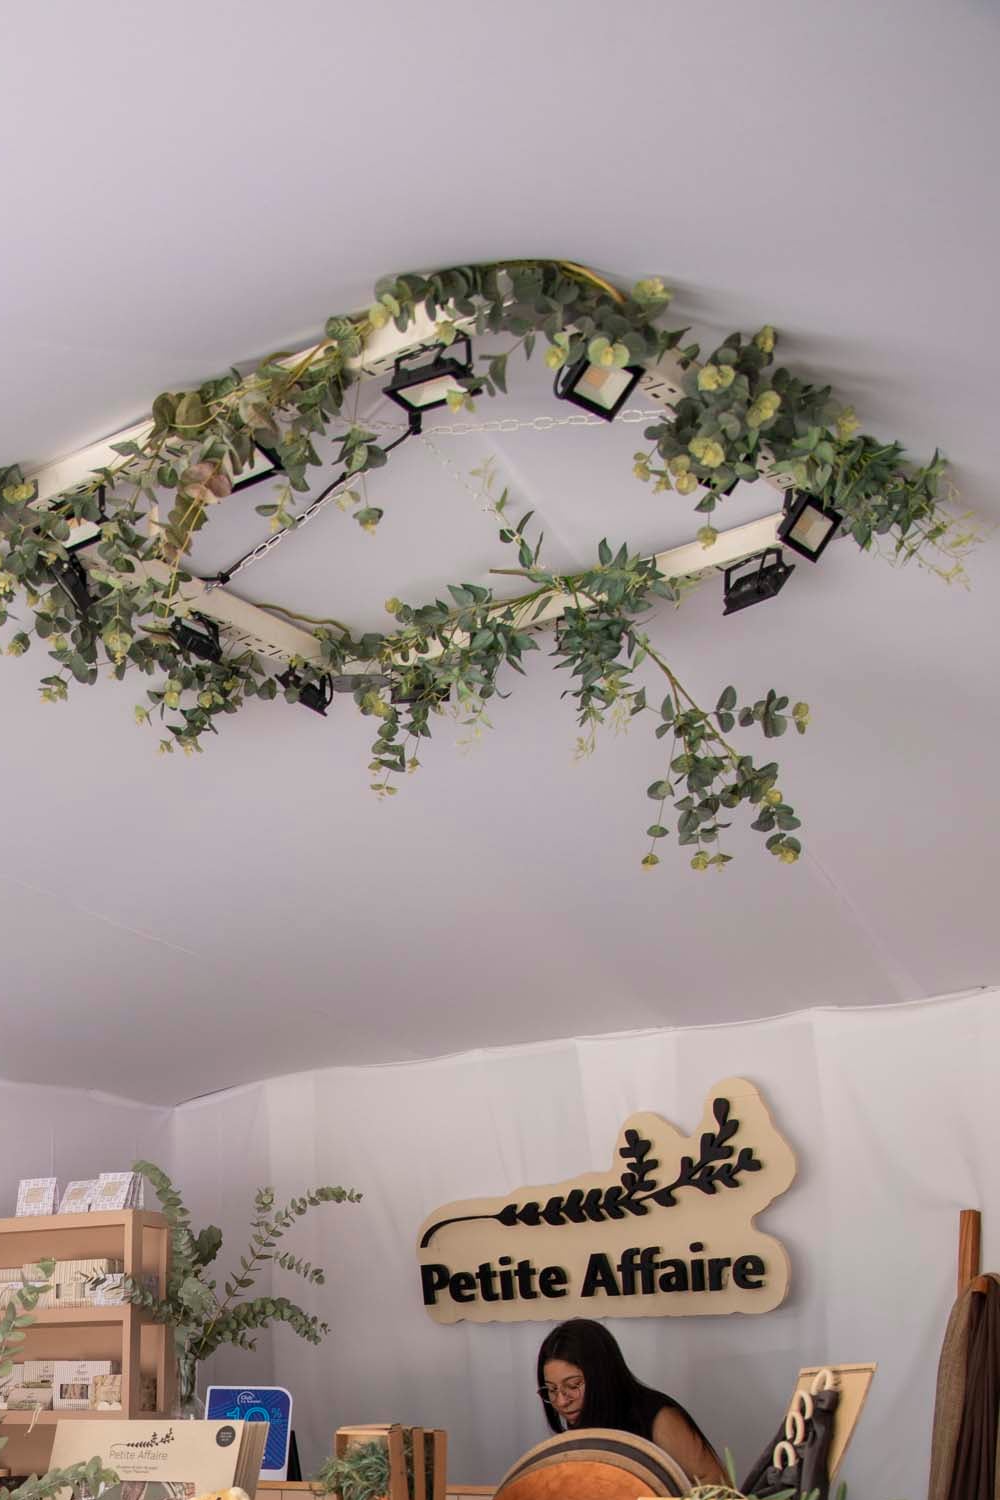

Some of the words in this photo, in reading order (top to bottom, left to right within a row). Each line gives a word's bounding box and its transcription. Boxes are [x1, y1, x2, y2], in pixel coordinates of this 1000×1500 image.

[420, 1255, 568, 1305] Petite
[580, 1242, 766, 1297] Affaire
[108, 1449, 137, 1460] Petite
[137, 1449, 168, 1461] Affaire
